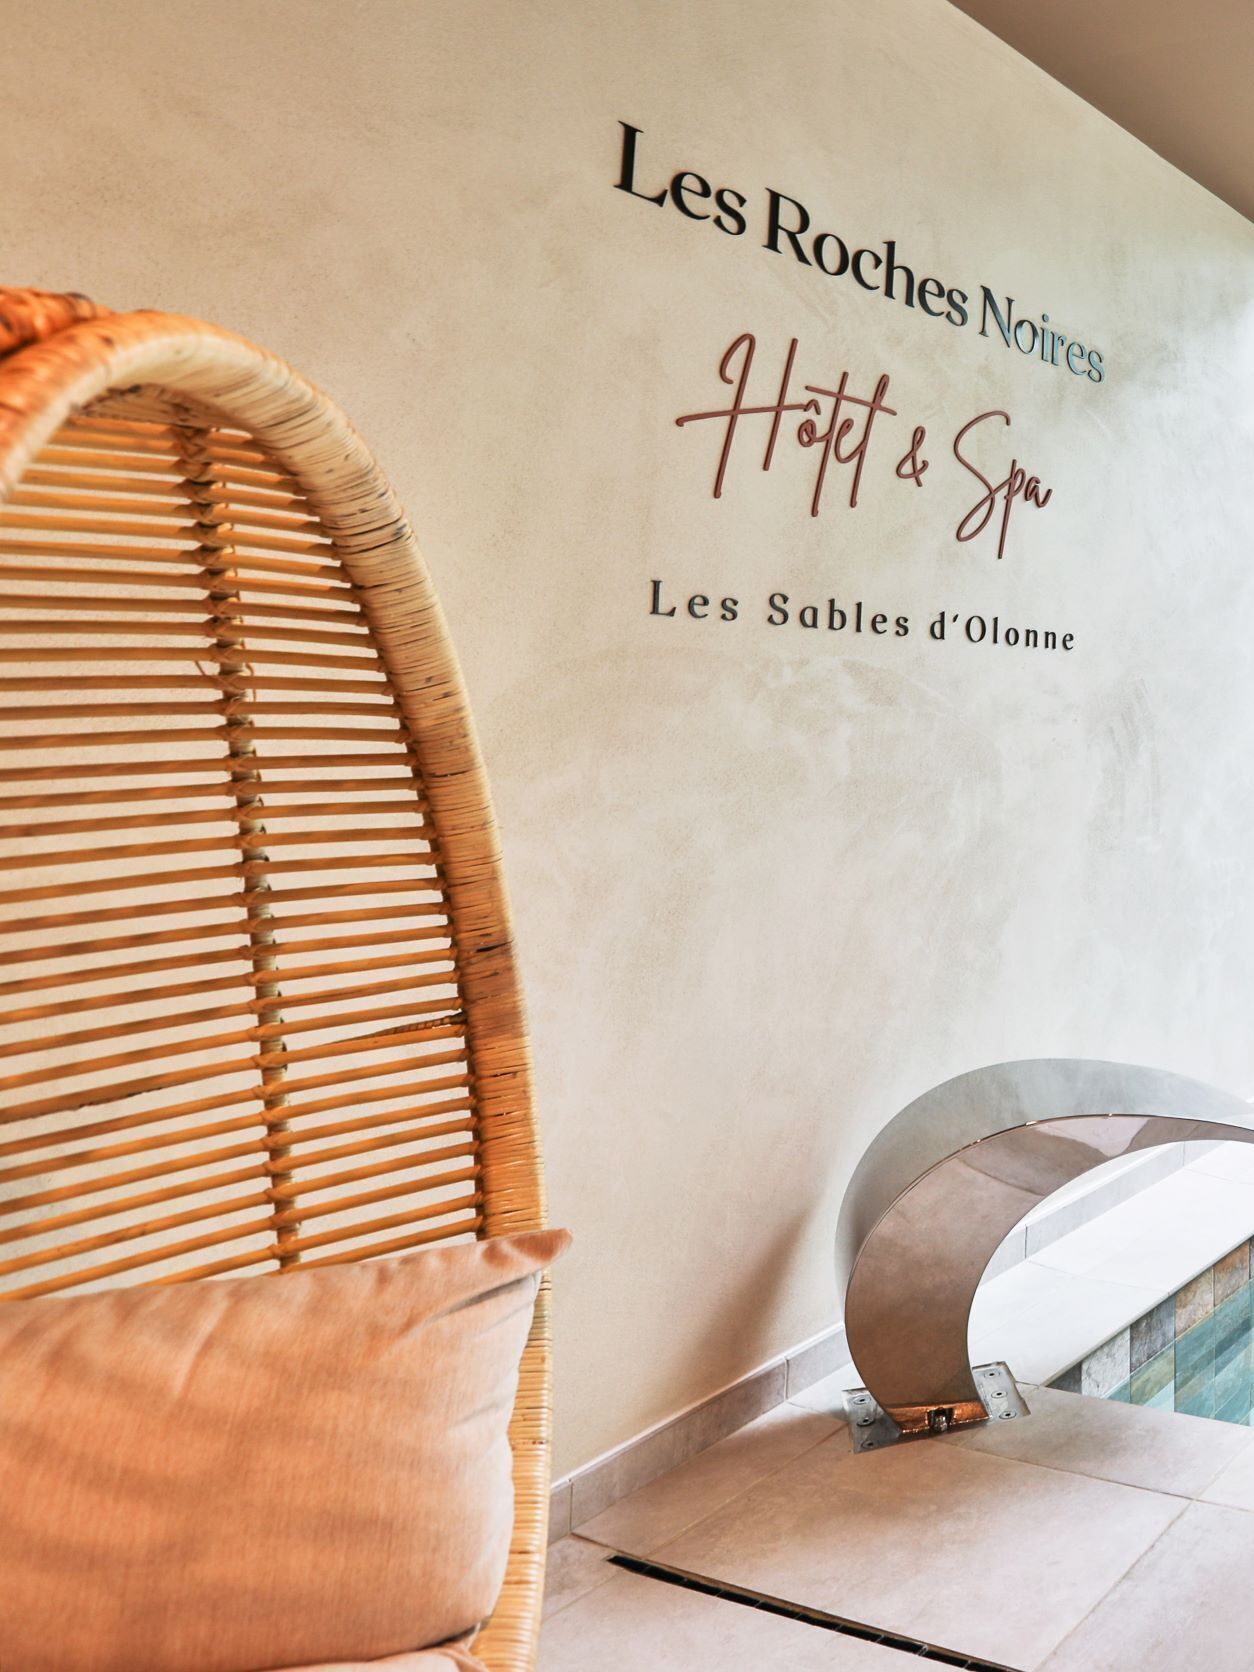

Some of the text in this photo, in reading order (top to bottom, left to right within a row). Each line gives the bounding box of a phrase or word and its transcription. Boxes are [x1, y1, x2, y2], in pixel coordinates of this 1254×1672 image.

[612, 120, 1106, 384] Les Roches Noires
[675, 333, 1053, 560] Hôtel & Spa
[649, 579, 1076, 653] Les Sables d'Olonne
